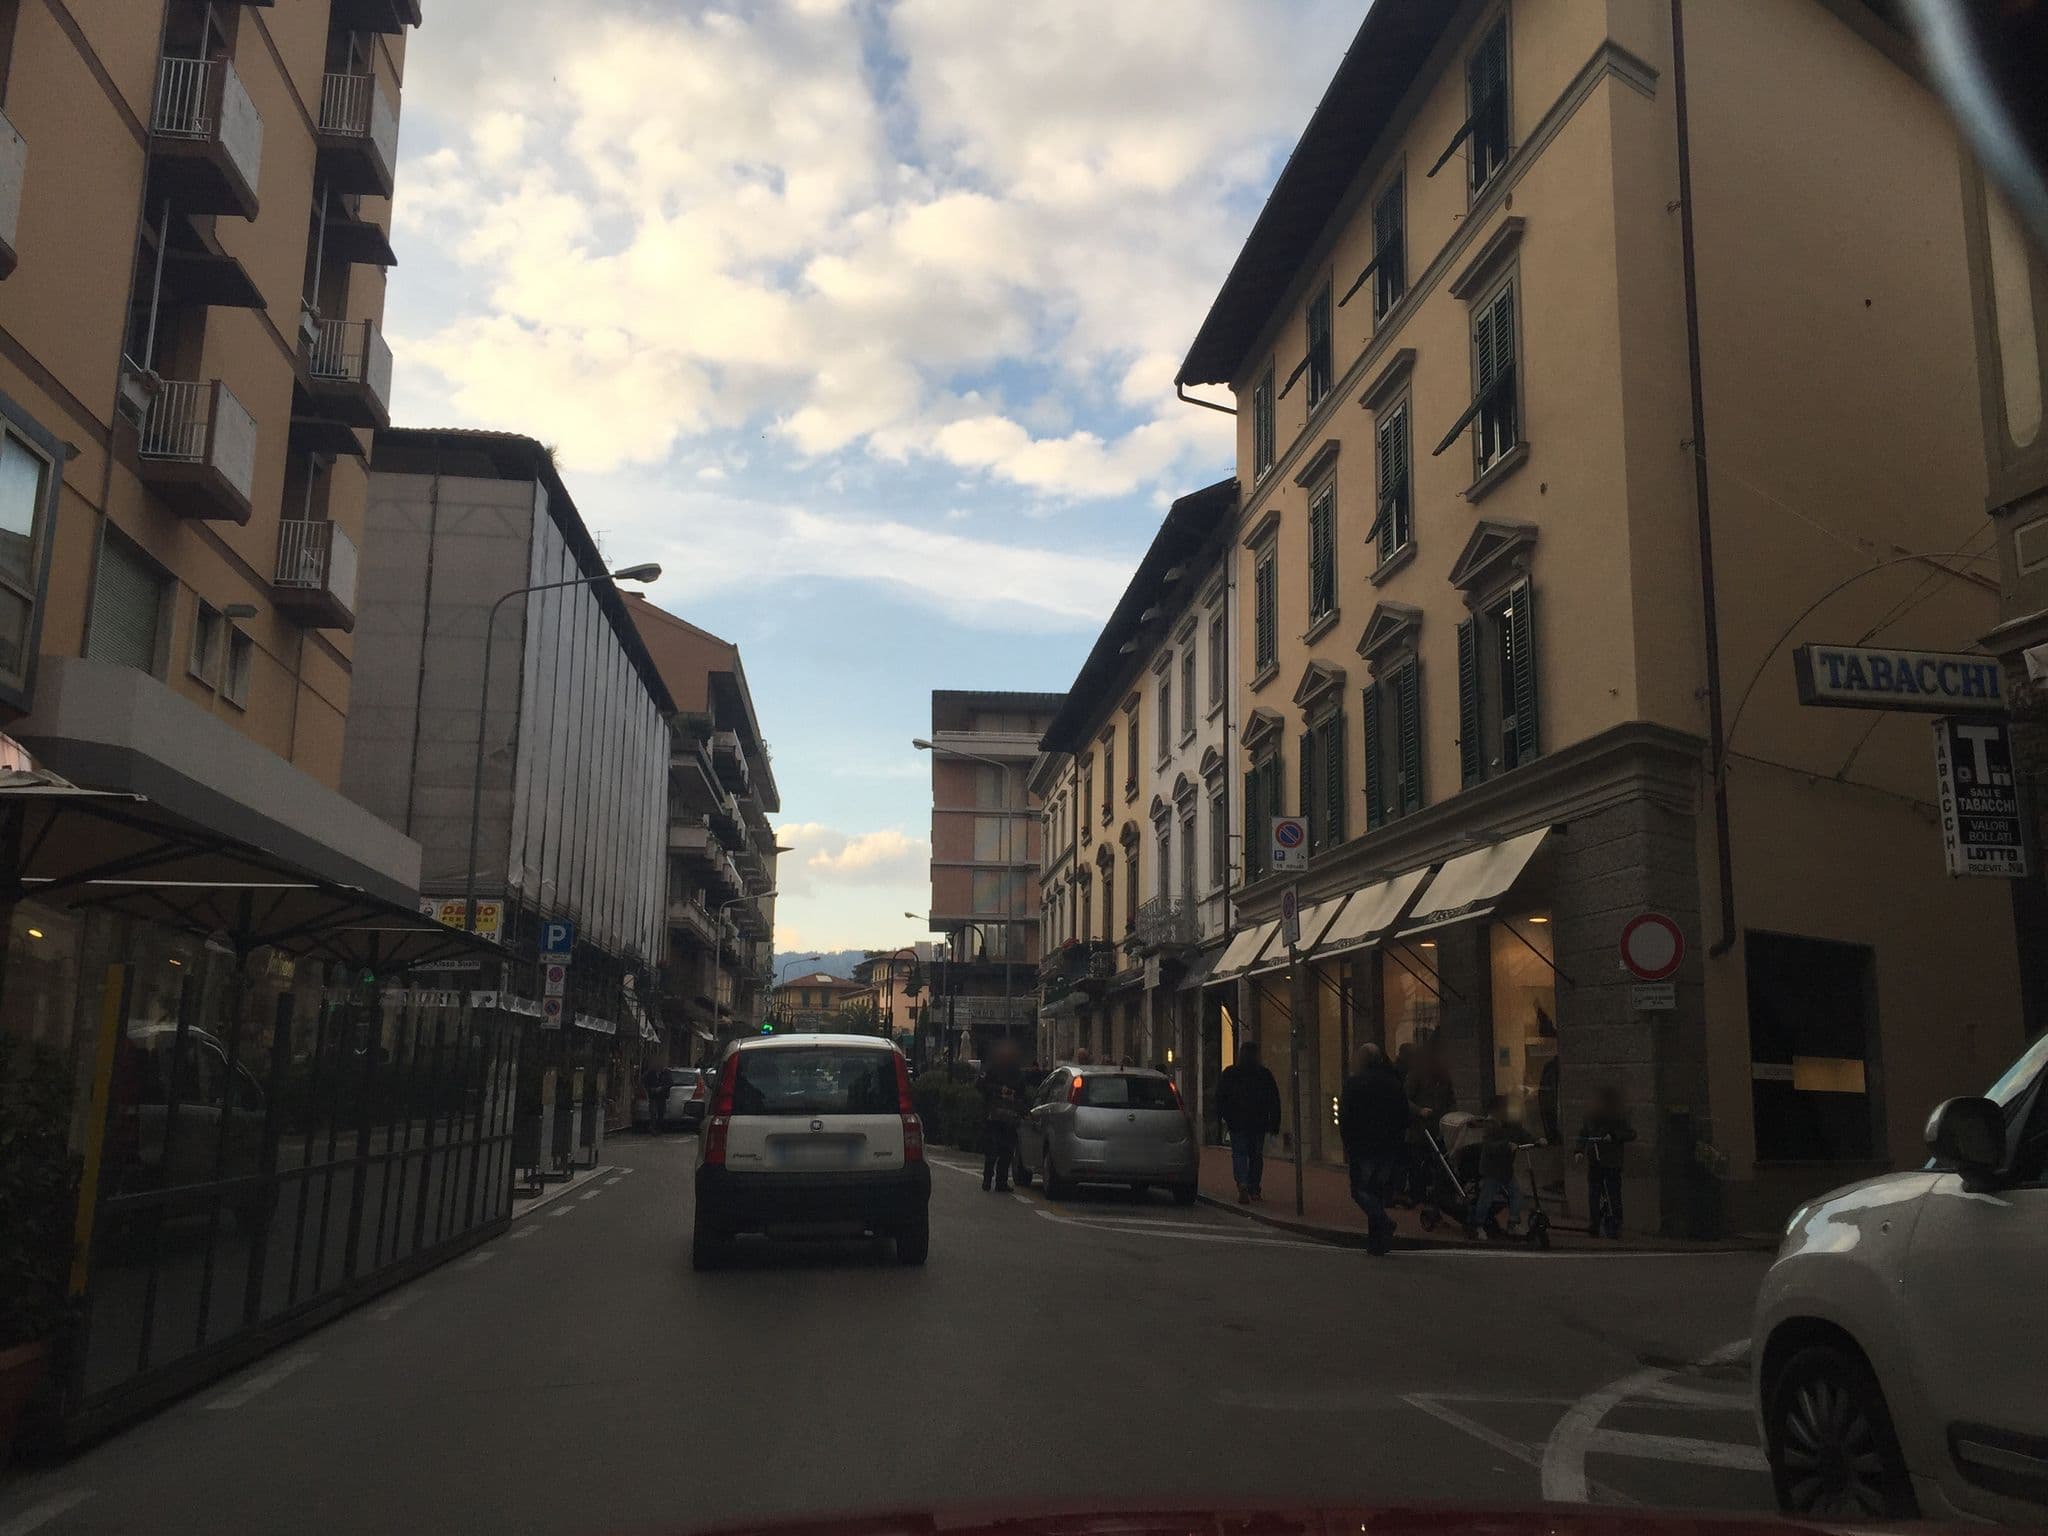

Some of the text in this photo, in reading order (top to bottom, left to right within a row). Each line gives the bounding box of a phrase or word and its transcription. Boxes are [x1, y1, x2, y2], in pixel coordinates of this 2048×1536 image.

[1820, 652, 2001, 699] TABACCHI
[1934, 725, 1956, 868] TABACCHI
[1957, 797, 2016, 814] TABACCHI
[1970, 819, 2009, 831] VALORI
[1968, 831, 2012, 842] BOLLATI
[1967, 847, 2018, 861] LOTTO
[547, 923, 567, 950] P
